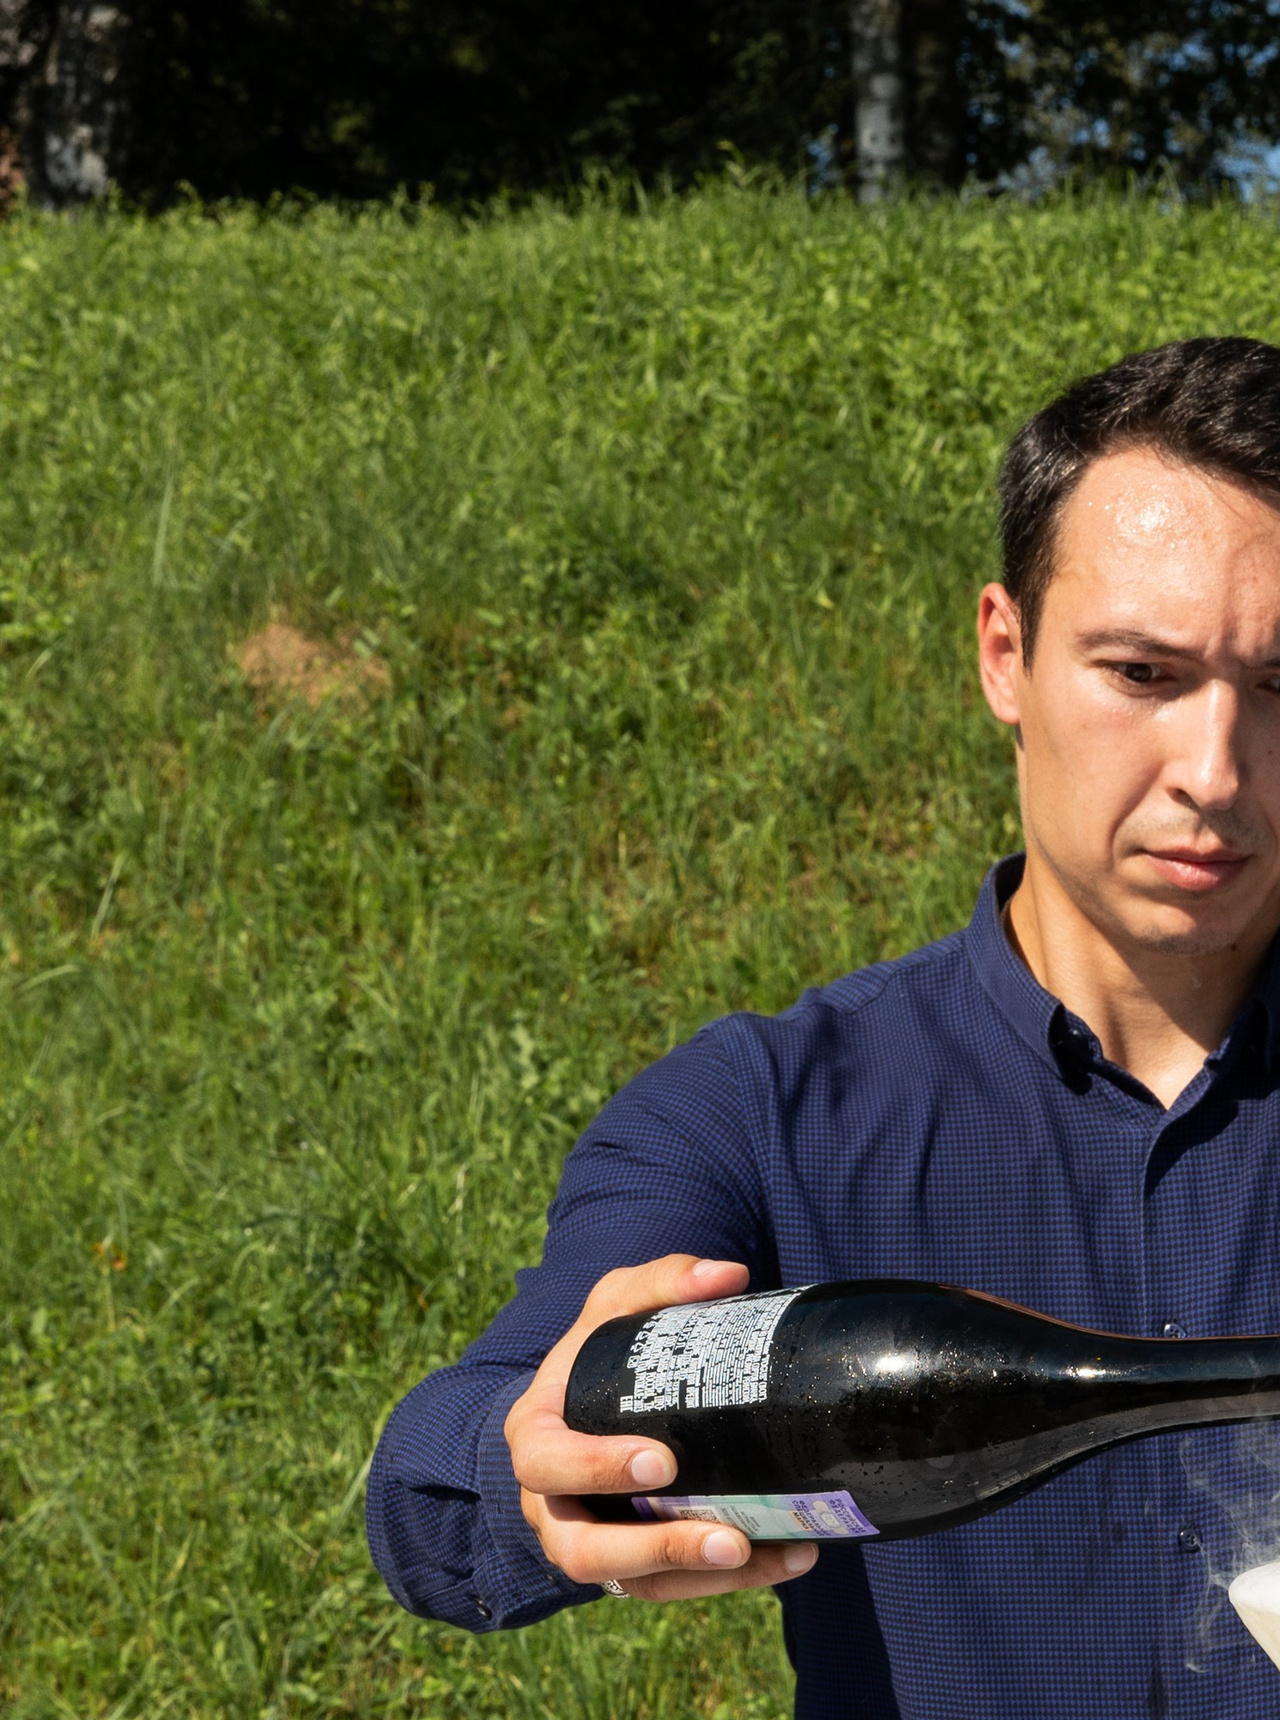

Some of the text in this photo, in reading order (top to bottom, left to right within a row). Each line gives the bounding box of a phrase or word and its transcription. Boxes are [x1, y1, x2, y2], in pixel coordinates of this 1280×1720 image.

[792, 1510, 809, 1530] МАРКА
[829, 1499, 859, 1535] ФЕДЕРАЦИЯ
[835, 1497, 867, 1534] РОССИЙСКАЯ
